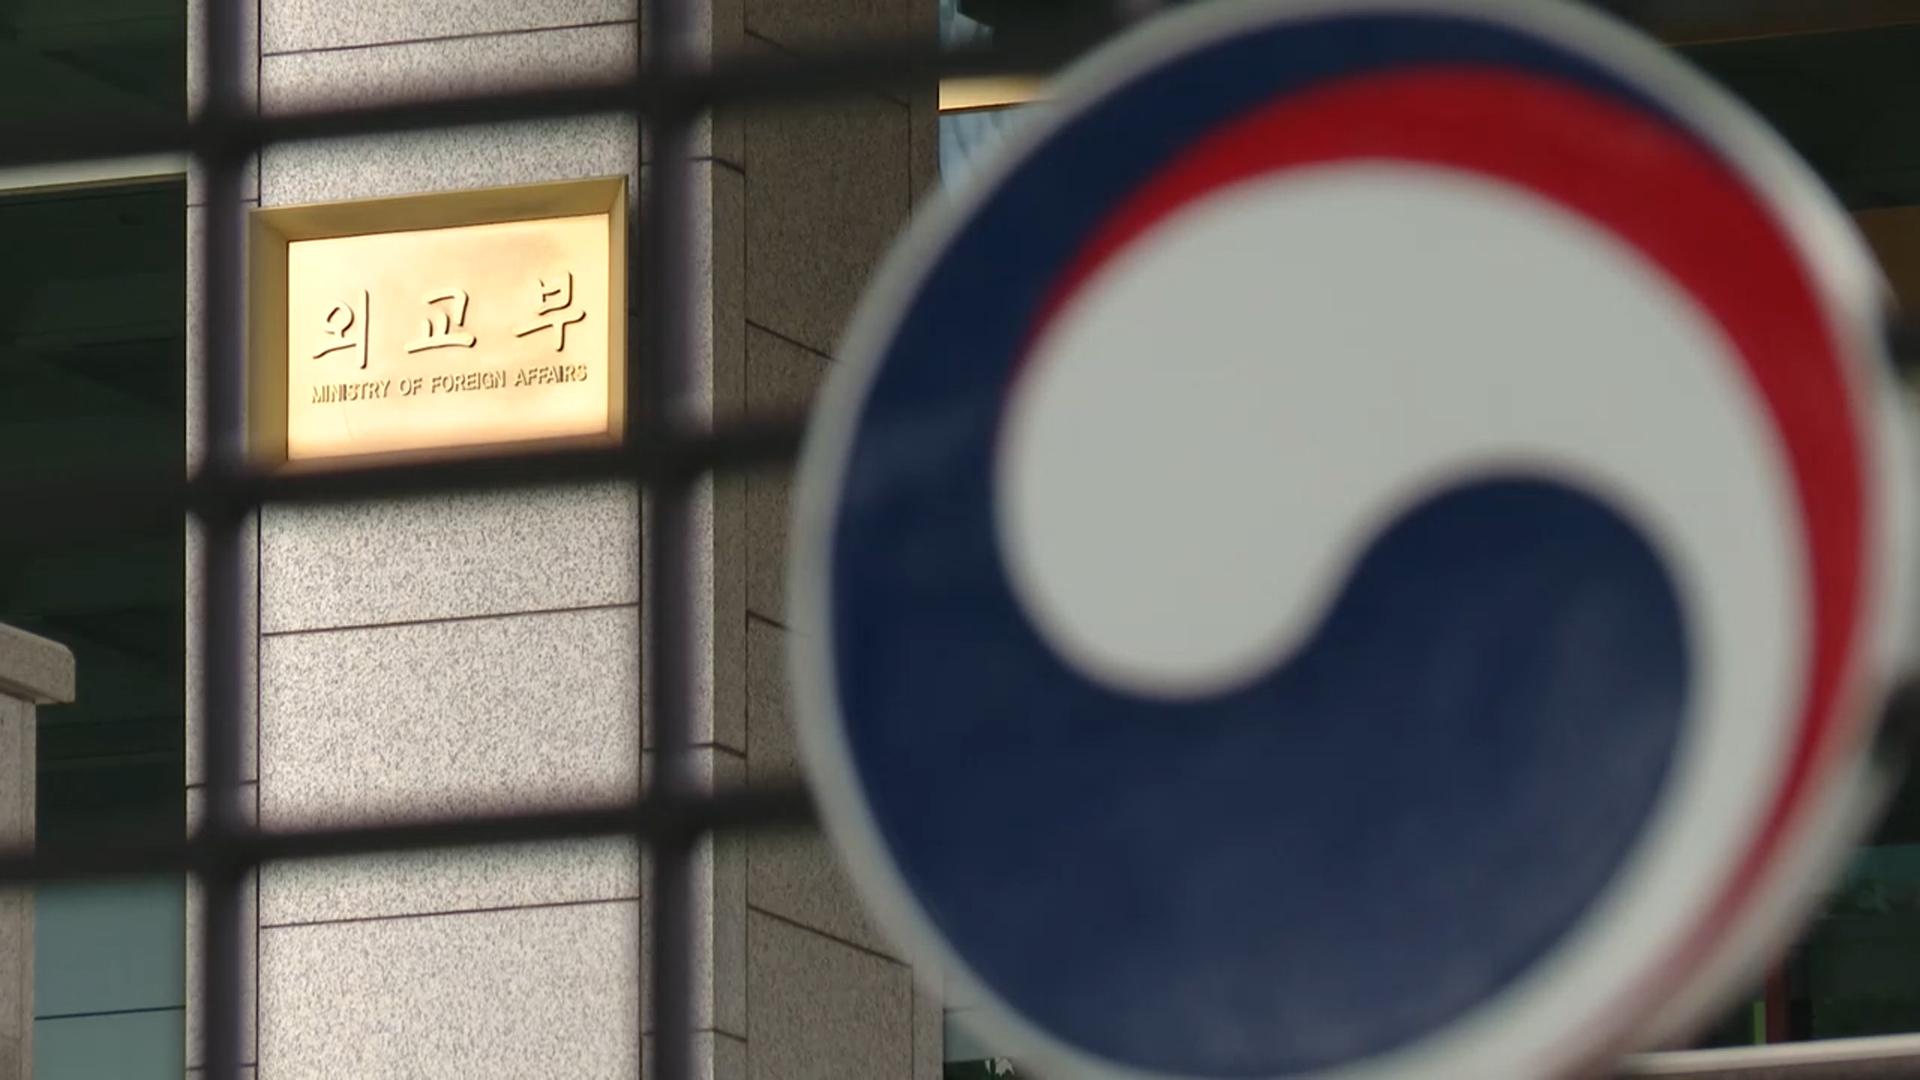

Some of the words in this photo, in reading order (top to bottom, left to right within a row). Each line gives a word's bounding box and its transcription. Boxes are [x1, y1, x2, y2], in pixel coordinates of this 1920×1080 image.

[311, 380, 391, 403] MINISTRY
[399, 376, 424, 396] OF
[431, 370, 507, 394] FOREIGN
[514, 363, 589, 387] AFFAIRS
